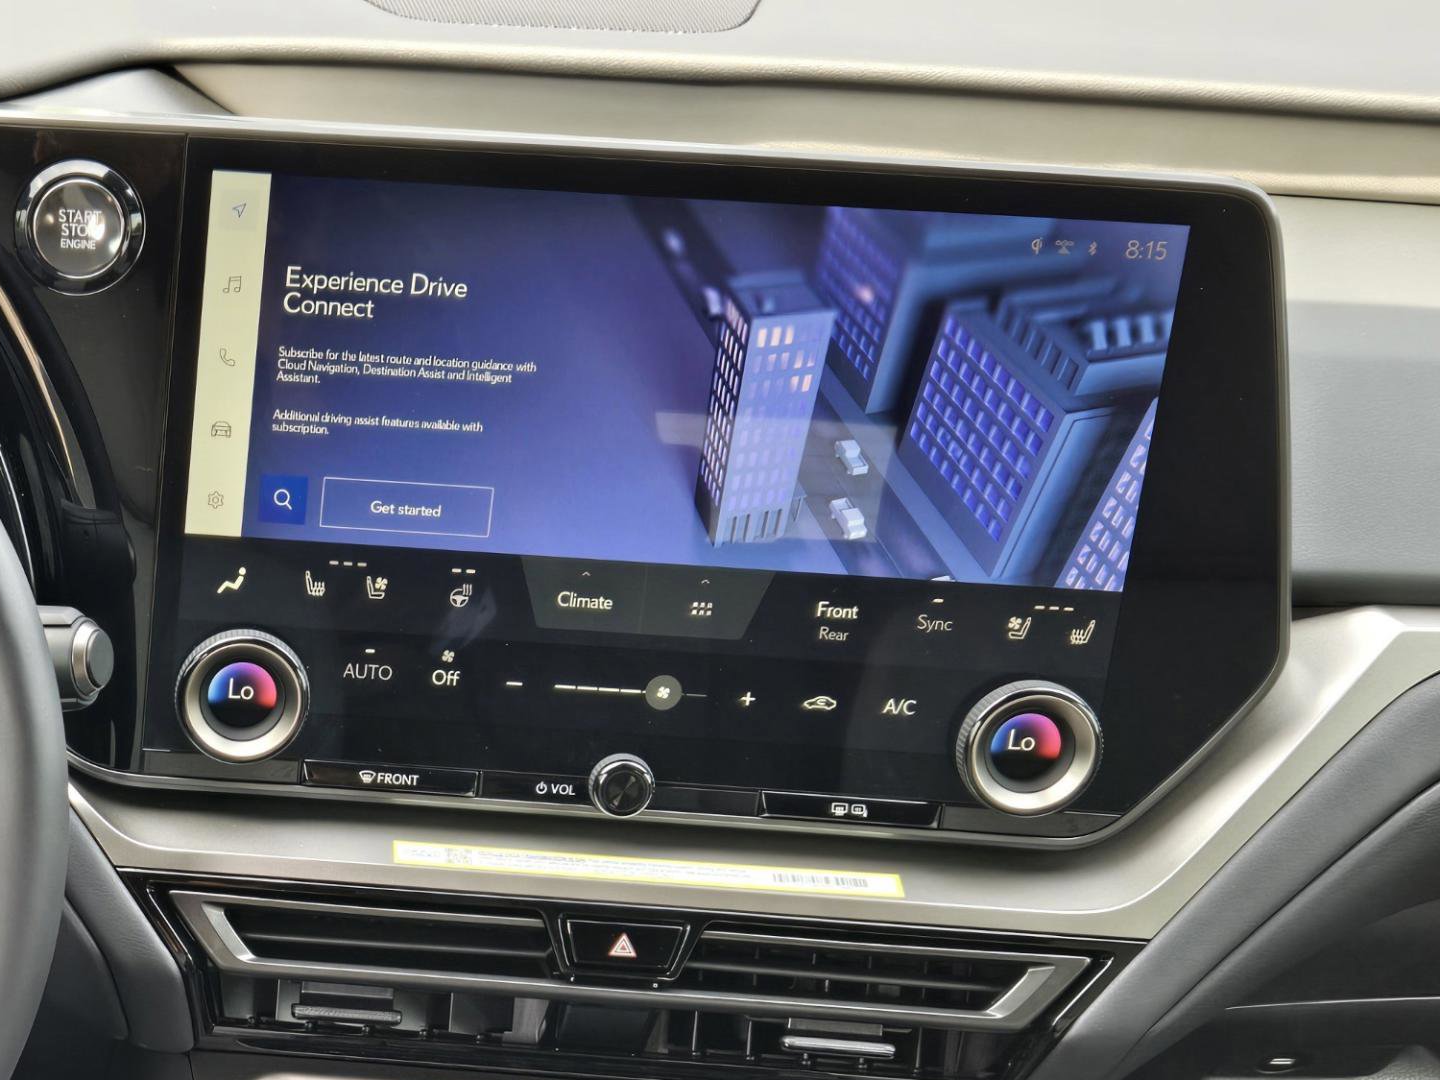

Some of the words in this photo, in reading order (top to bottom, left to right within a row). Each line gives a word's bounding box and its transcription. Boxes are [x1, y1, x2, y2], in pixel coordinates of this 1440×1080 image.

[58, 209, 102, 223] START
[61, 223, 97, 237] STO
[60, 238, 96, 250] ENGINE
[1125, 240, 1168, 260] 8:15
[286, 266, 404, 294] Experience
[410, 272, 468, 298] Drive
[283, 292, 375, 318] Connect
[278, 346, 324, 360] Subscribe
[326, 349, 340, 360] for
[342, 350, 356, 362] the
[358, 351, 384, 363] latest
[386, 354, 412, 365] route
[414, 356, 432, 366] and
[433, 356, 470, 368] location
[472, 360, 513, 372] guidance
[516, 362, 536, 372] with
[276, 371, 320, 384] Assistant.
[278, 358, 306, 370] Cloud
[308, 361, 360, 375] Navigation,
[363, 364, 416, 378] Destination
[418, 367, 445, 380] Assist
[447, 370, 466, 380] and
[467, 371, 512, 384] Intelligent
[272, 409, 320, 422] Additional
[321, 412, 352, 426] driving
[354, 416, 379, 426] assist
[382, 416, 420, 428] features
[421, 419, 460, 431] available
[462, 422, 483, 432] with
[272, 422, 330, 434] subscription.
[370, 500, 395, 514] Get
[398, 504, 442, 518] started
[557, 592, 613, 610] Climate
[816, 601, 858, 620] Front
[916, 614, 953, 633] Sync
[818, 626, 849, 642] Rear
[343, 664, 392, 680] AUTO
[432, 670, 460, 687] Off
[228, 678, 254, 700] Lo
[882, 699, 917, 716] A/C
[1008, 728, 1036, 751] Lo
[377, 772, 420, 786] FRONT
[552, 784, 576, 796] VOL
